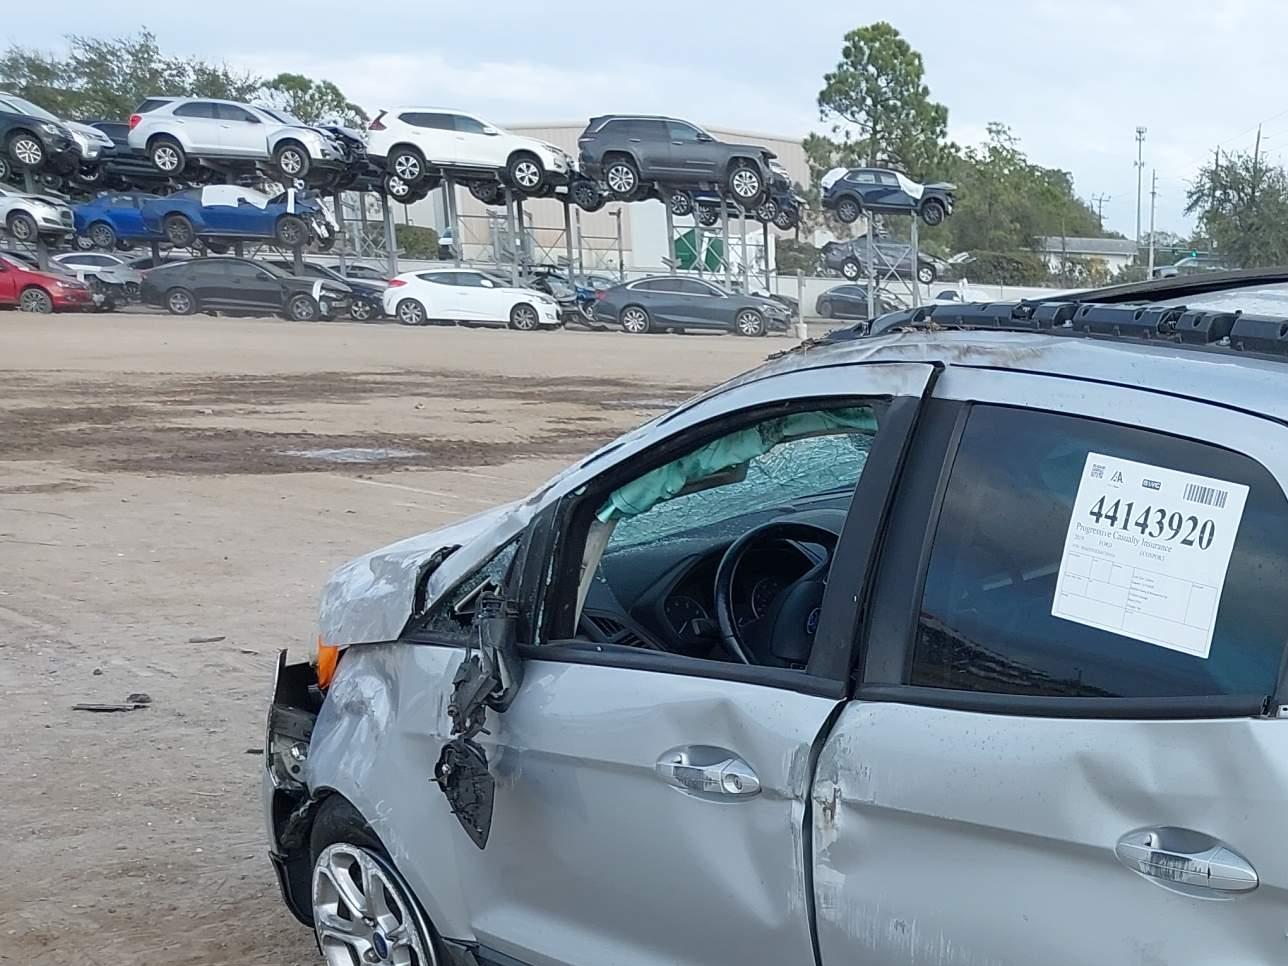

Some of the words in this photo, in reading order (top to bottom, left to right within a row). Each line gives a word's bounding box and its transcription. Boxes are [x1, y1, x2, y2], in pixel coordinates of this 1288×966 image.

[1076, 522, 1112, 539] Progressive
[1112, 530, 1140, 546] Casualty
[1141, 538, 1173, 553] Insurance
[1089, 495, 1216, 551] 44143920
